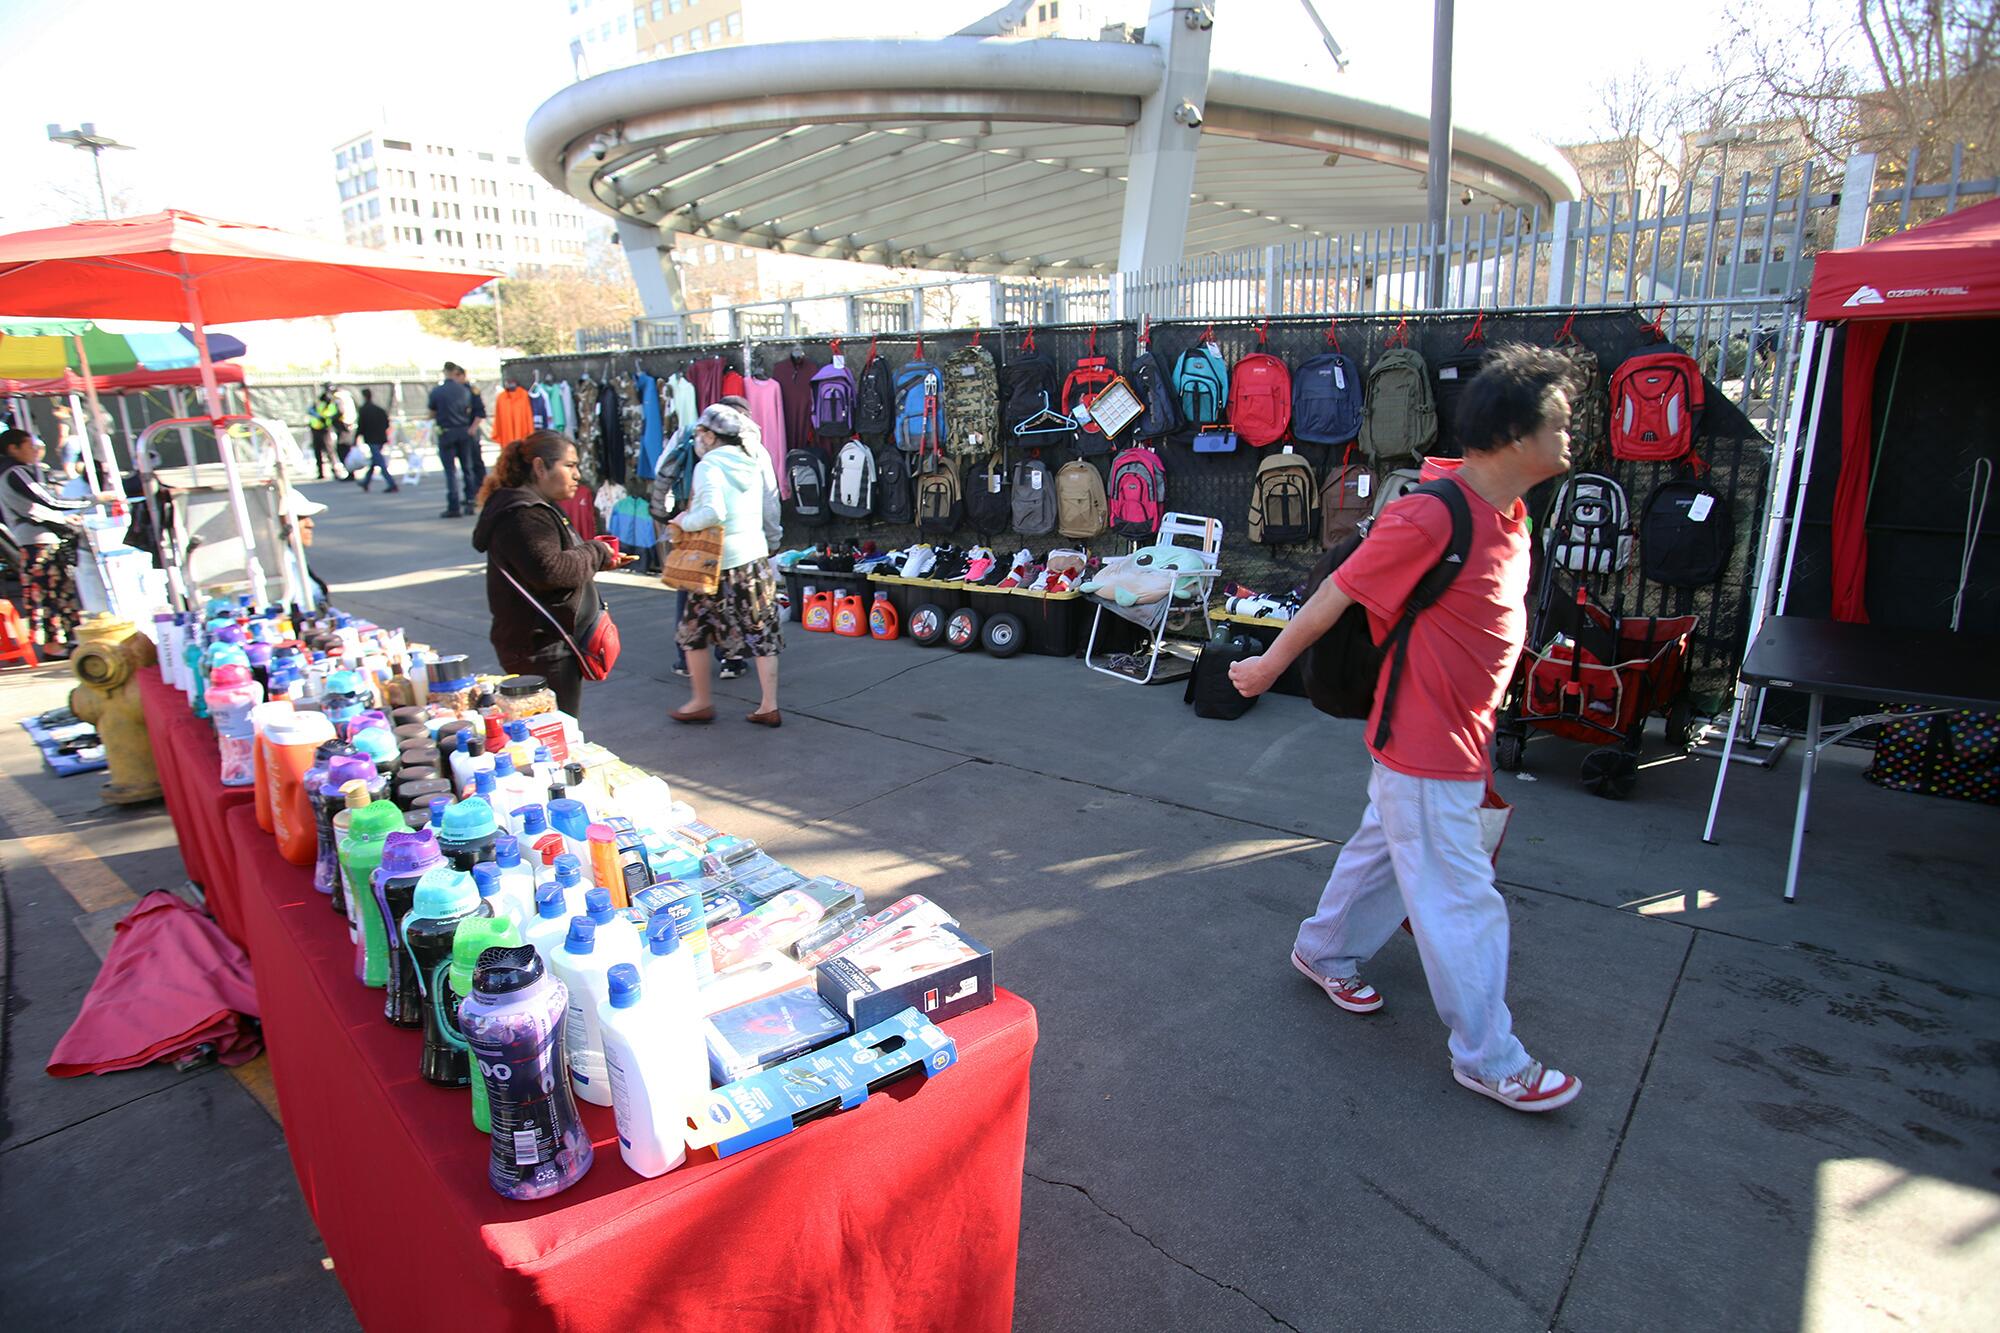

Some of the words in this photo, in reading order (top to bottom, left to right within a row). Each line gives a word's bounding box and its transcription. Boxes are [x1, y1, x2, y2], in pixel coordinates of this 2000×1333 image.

[1886, 288, 1929, 298] OZARK
[1931, 286, 1968, 296] TRAIL
[728, 1085, 765, 1124] WORK
